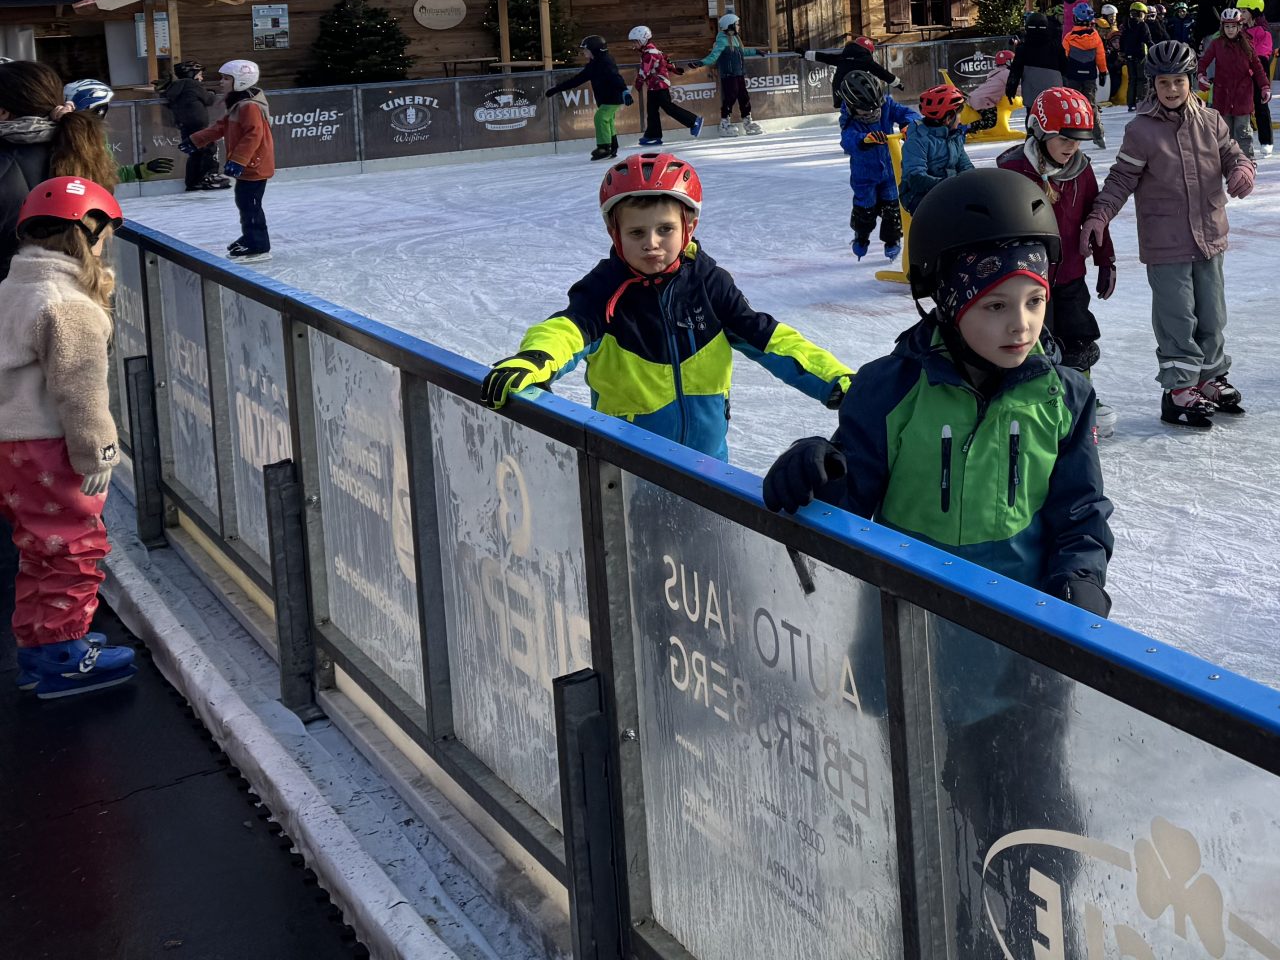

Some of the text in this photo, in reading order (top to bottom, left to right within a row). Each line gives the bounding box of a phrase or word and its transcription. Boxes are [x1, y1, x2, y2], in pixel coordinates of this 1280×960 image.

[743, 73, 799, 89] OSSEDER
[379, 95, 440, 111] UNERTL
[561, 88, 595, 108] WI
[671, 86, 717, 104] Bauer
[473, 104, 537, 122] Gassner
[291, 123, 340, 138] maier
[319, 133, 332, 141] .de
[152, 138, 181, 147] WAS
[393, 133, 430, 145] Weißbier
